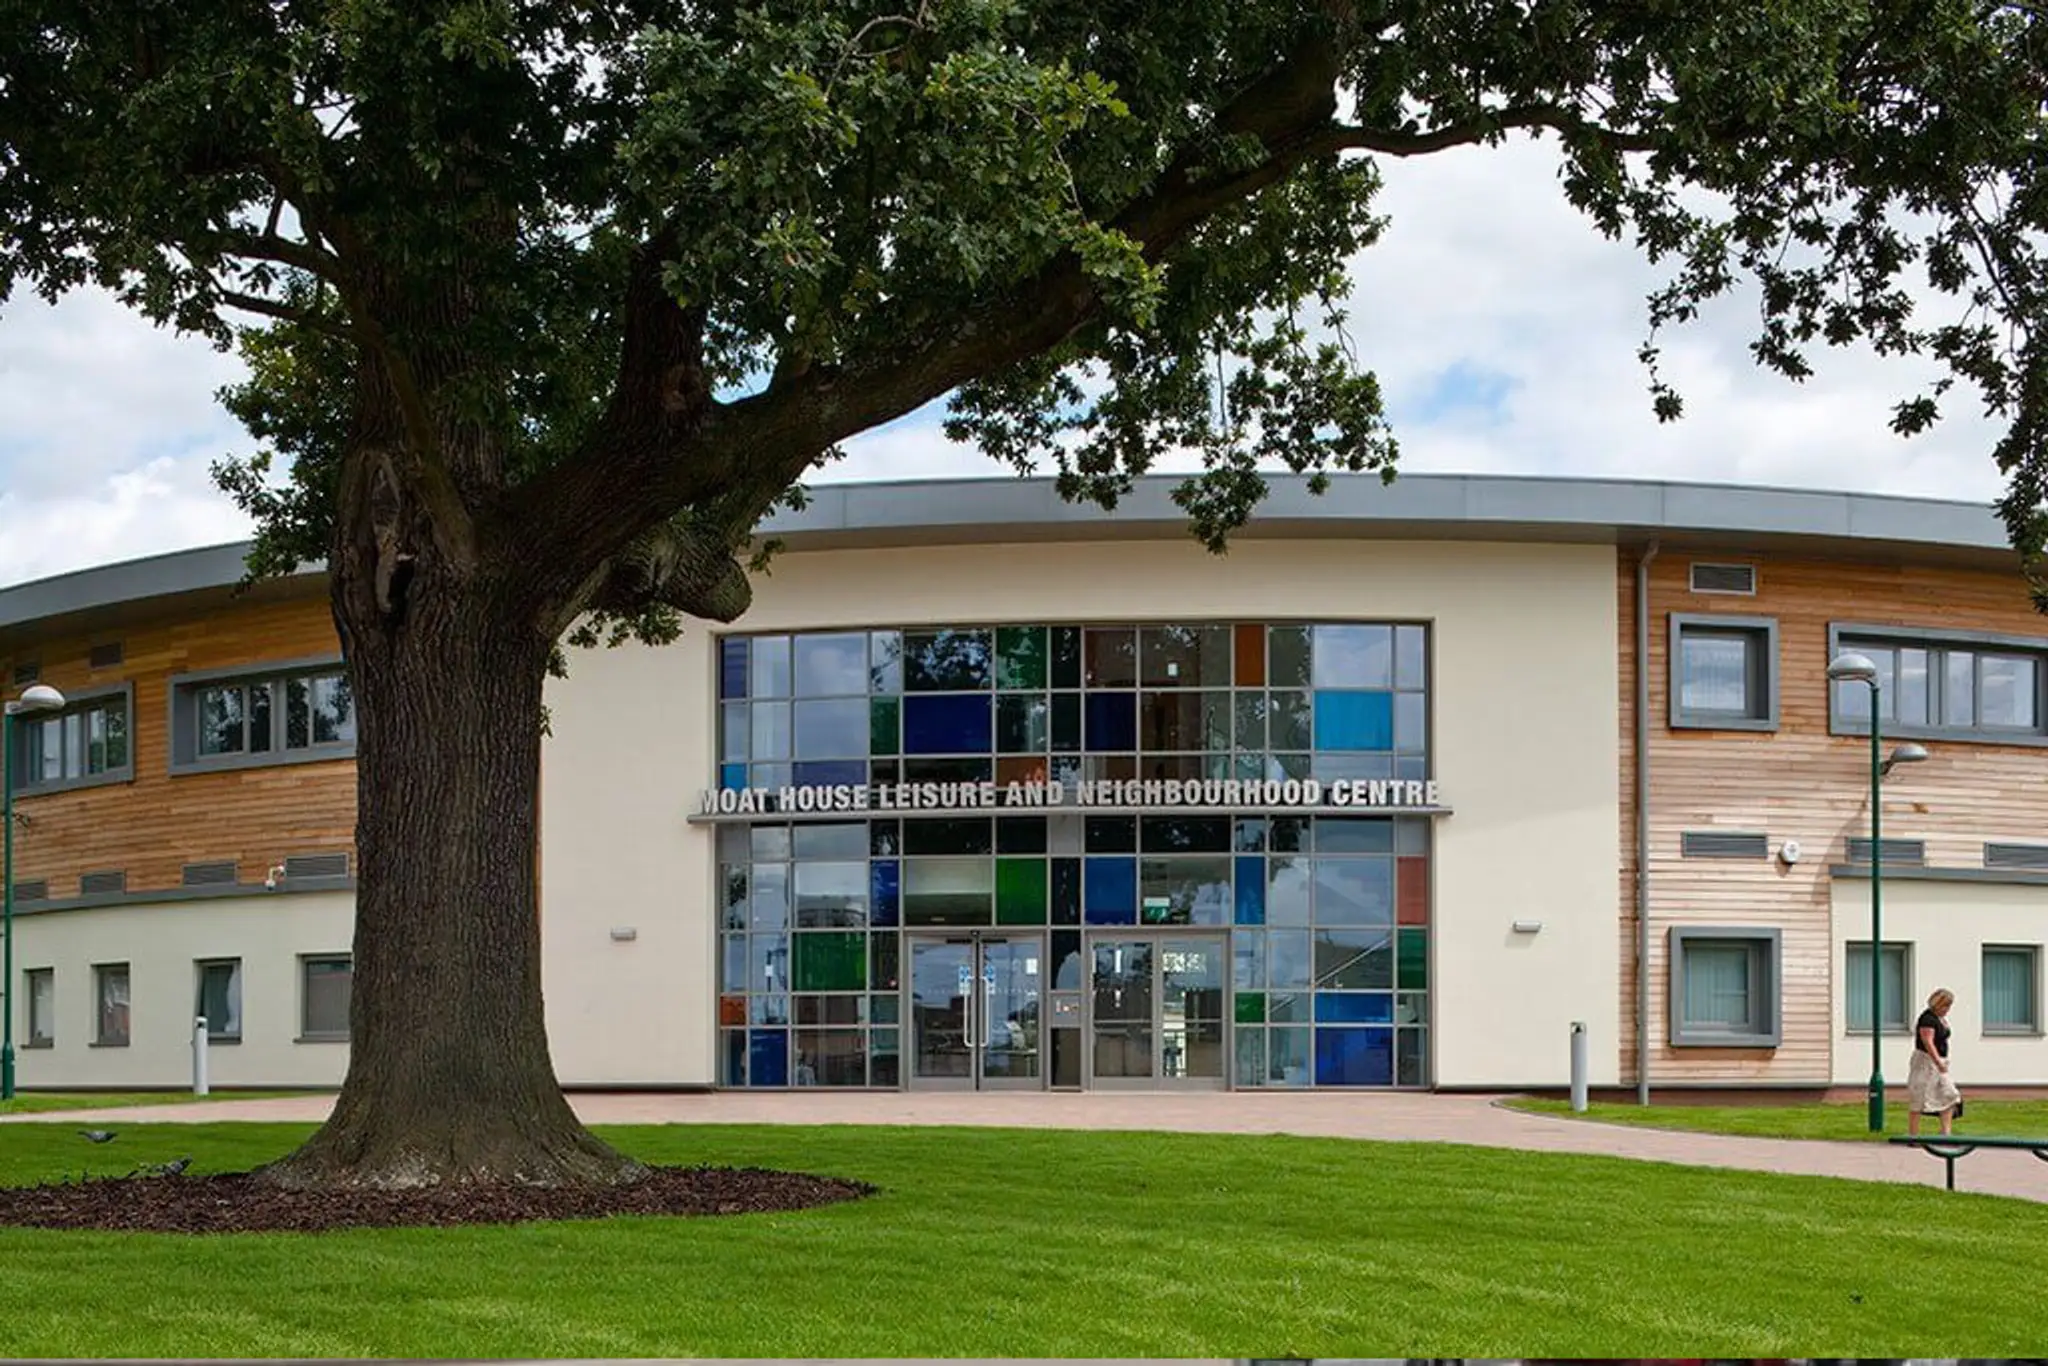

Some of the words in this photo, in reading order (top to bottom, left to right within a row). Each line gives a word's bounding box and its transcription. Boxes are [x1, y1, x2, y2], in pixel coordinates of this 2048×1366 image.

[701, 787, 767, 814] MOAT
[780, 785, 869, 812] HOUSE
[880, 781, 995, 809] LEISURE
[1005, 781, 1063, 805] AND
[1077, 779, 1321, 805] NEIGHBOURHOOD
[1331, 780, 1441, 805] CENTRE
